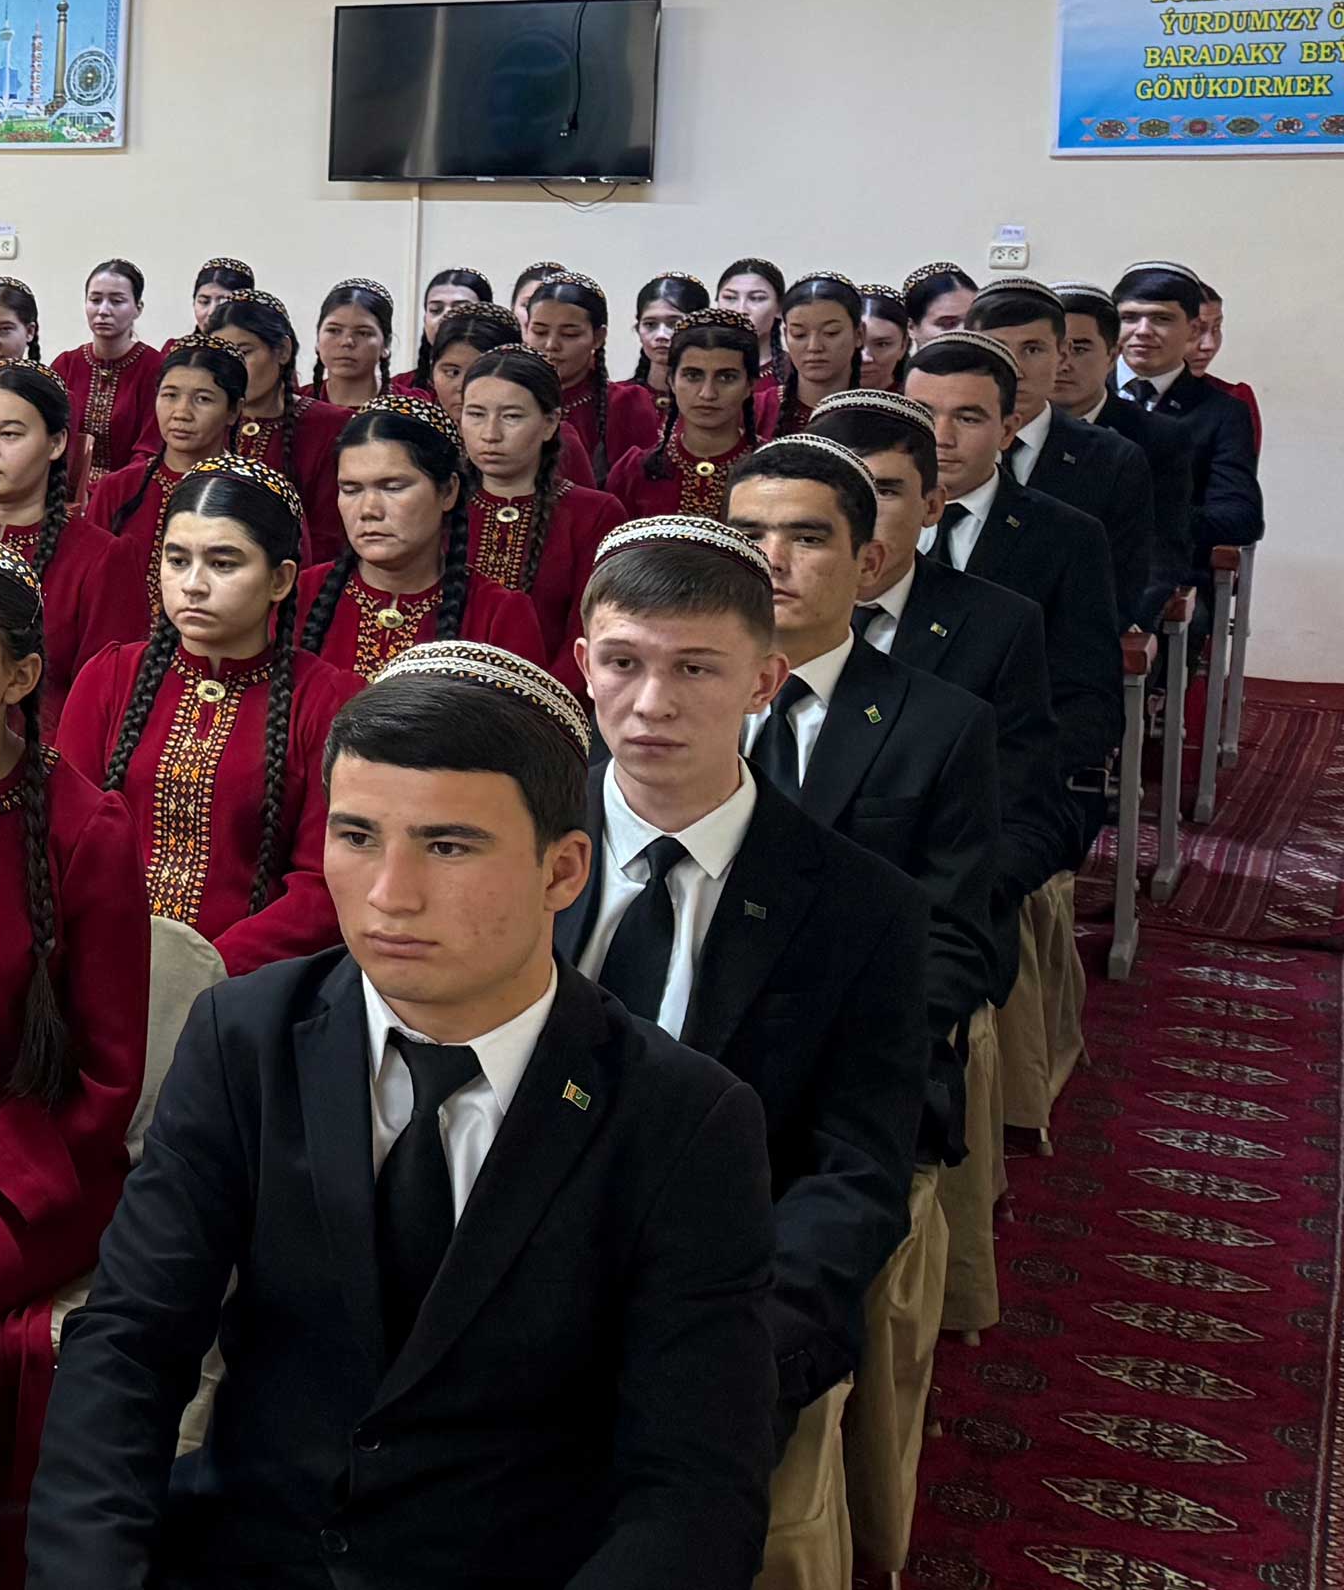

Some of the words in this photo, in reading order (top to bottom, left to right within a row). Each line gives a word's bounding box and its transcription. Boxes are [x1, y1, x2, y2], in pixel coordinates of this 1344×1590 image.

[1160, 7, 1322, 35] ÝURDUMYZY
[1144, 43, 1287, 69] BARADAKY
[1135, 73, 1332, 100] GÖNÜKDIRMEK
